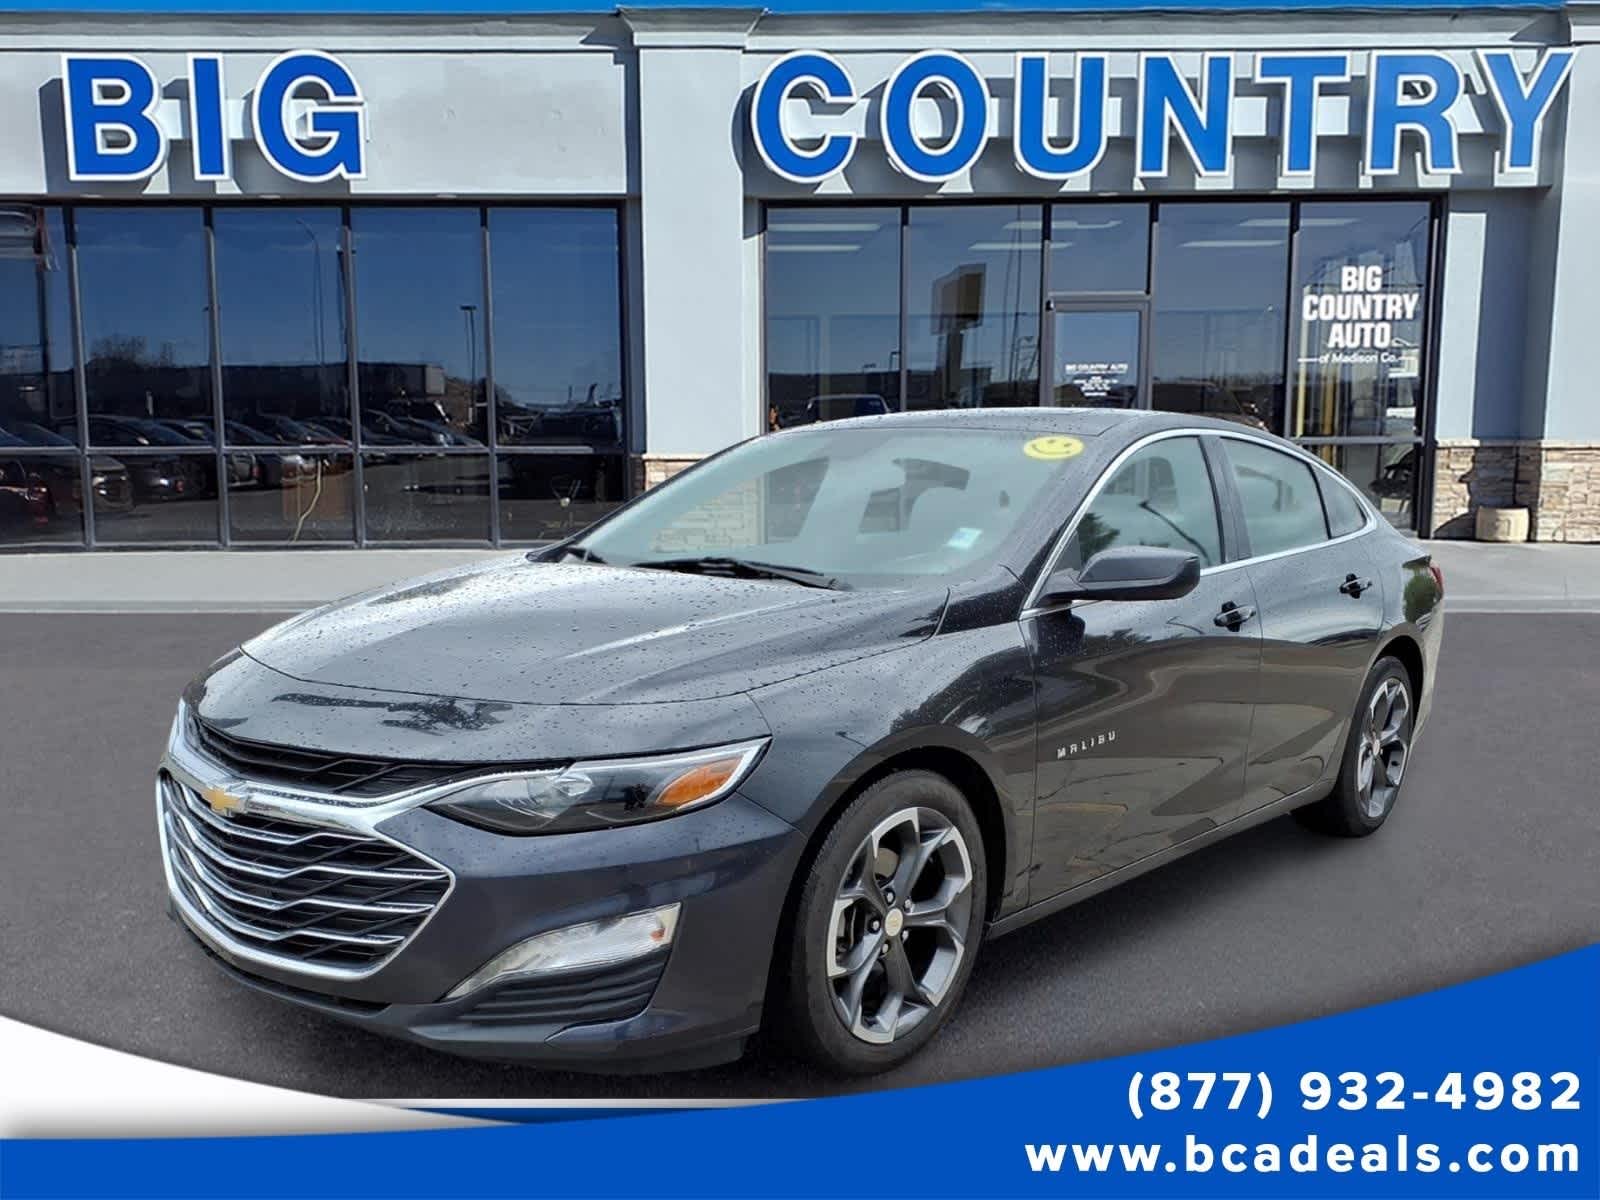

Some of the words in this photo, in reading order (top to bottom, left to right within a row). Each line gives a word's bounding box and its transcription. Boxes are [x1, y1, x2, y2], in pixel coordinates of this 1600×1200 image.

[62, 50, 367, 182] BIG
[751, 49, 1574, 186] COUNTRY
[1341, 265, 1383, 292] BIG
[1302, 293, 1420, 321] COUNTRY
[1327, 322, 1392, 349] AUTO
[1319, 354, 1329, 364] of
[1331, 353, 1378, 363] Madison
[1380, 352, 1399, 363] Co.
[1057, 730, 1116, 759] MALIBU
